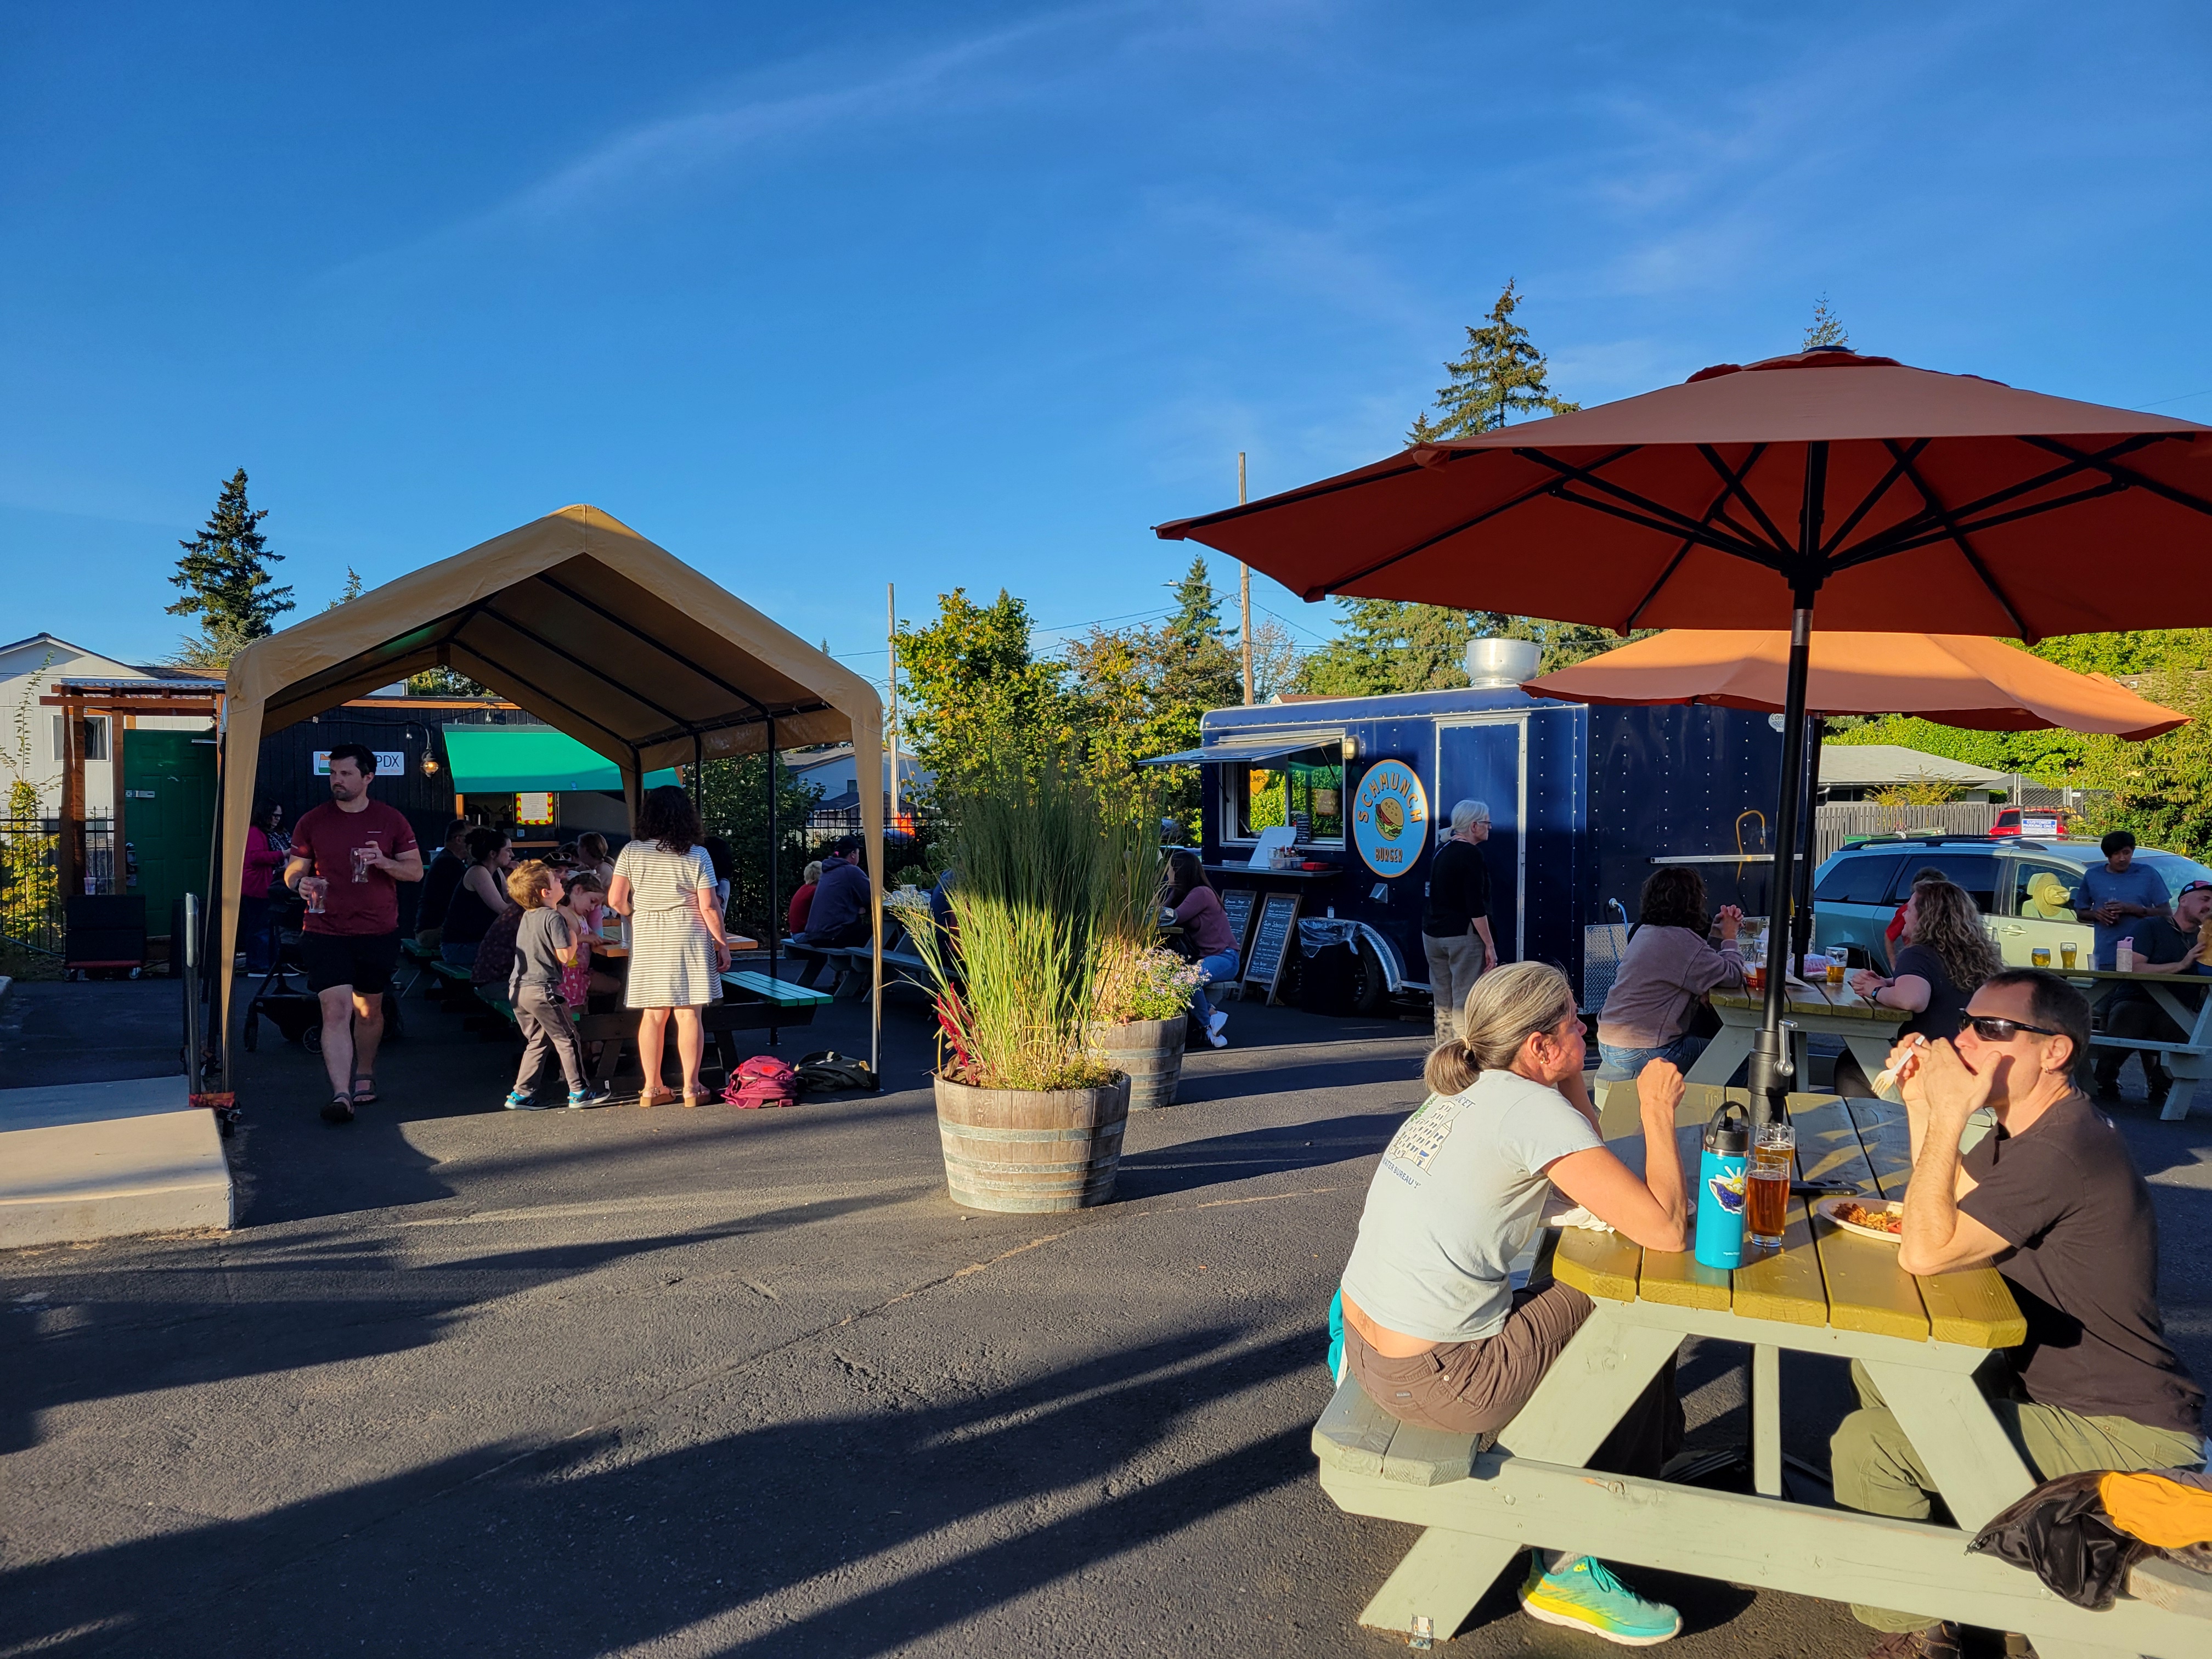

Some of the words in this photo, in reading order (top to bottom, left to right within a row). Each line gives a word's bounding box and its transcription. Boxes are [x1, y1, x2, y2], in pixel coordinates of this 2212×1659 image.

[1357, 771, 1423, 823] SCHMUNCH
[1375, 847, 1403, 863] BURGER
[1393, 1166, 1414, 1186] BUREAU
